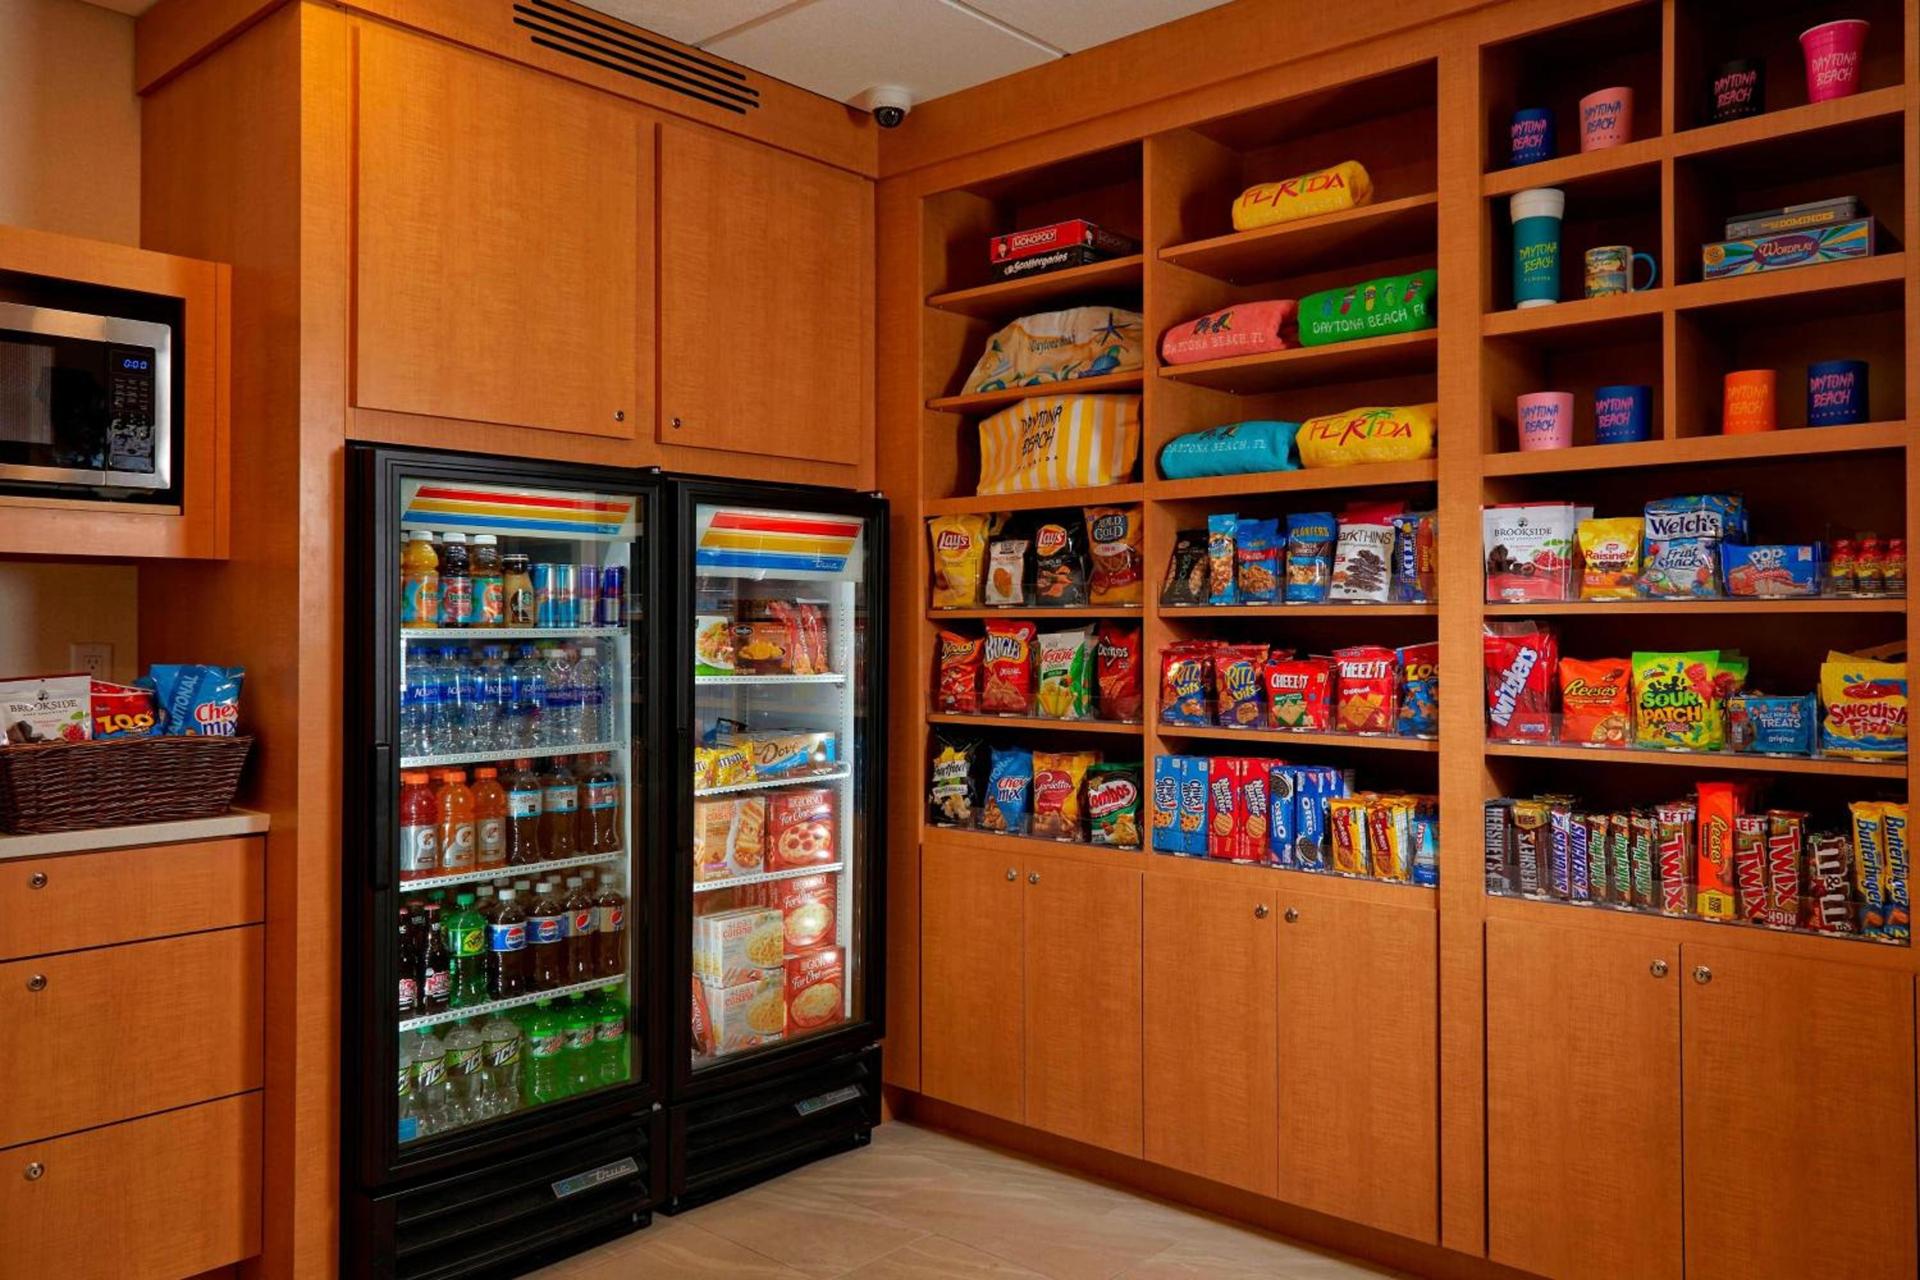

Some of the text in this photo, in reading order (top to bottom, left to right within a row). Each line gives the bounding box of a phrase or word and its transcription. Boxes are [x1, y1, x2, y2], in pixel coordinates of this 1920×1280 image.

[1812, 51, 1857, 73] DAYTONA
[1817, 68, 1853, 87] BEACH
[1717, 88, 1752, 108] BEACH
[1015, 231, 1056, 248] MONOPOLY
[1312, 318, 1365, 335] DAYTONA
[1368, 304, 1409, 328] BEACH
[1813, 389, 1851, 409] BEACH
[1092, 525, 1124, 541] GOLD
[1494, 527, 1552, 538] BROOKSIDE
[1649, 514, 1719, 536] Welch's
[938, 530, 971, 551] Lay's
[1038, 529, 1067, 546] Lay's
[985, 635, 1021, 663] BUGLES
[1225, 665, 1255, 689] RITZ
[1565, 679, 1619, 697] Reese's
[10, 699, 78, 713] BROOKSIDE
[1642, 691, 1699, 708] SOUR
[194, 702, 238, 722] Chex
[1643, 705, 1703, 723] PATCH
[1761, 718, 1801, 729] TREATS
[1850, 718, 1895, 736] Fish
[1212, 782, 1225, 814] Butter
[1219, 777, 1233, 812] Nutter
[1245, 784, 1259, 816] Butter
[1253, 779, 1267, 814] Nutter
[1486, 807, 1504, 872] HERSHEY'S
[1552, 828, 1569, 892] SNICKERS
[1571, 823, 1588, 886] SNICKERS
[1856, 818, 1882, 908] Butterfinger
[1885, 815, 1909, 906] Butterfinger
[1660, 832, 1688, 911] TWIX
[1769, 826, 1799, 907] TWIX
[1736, 843, 1767, 918] TWIX
[1767, 909, 1797, 926] RIGH
